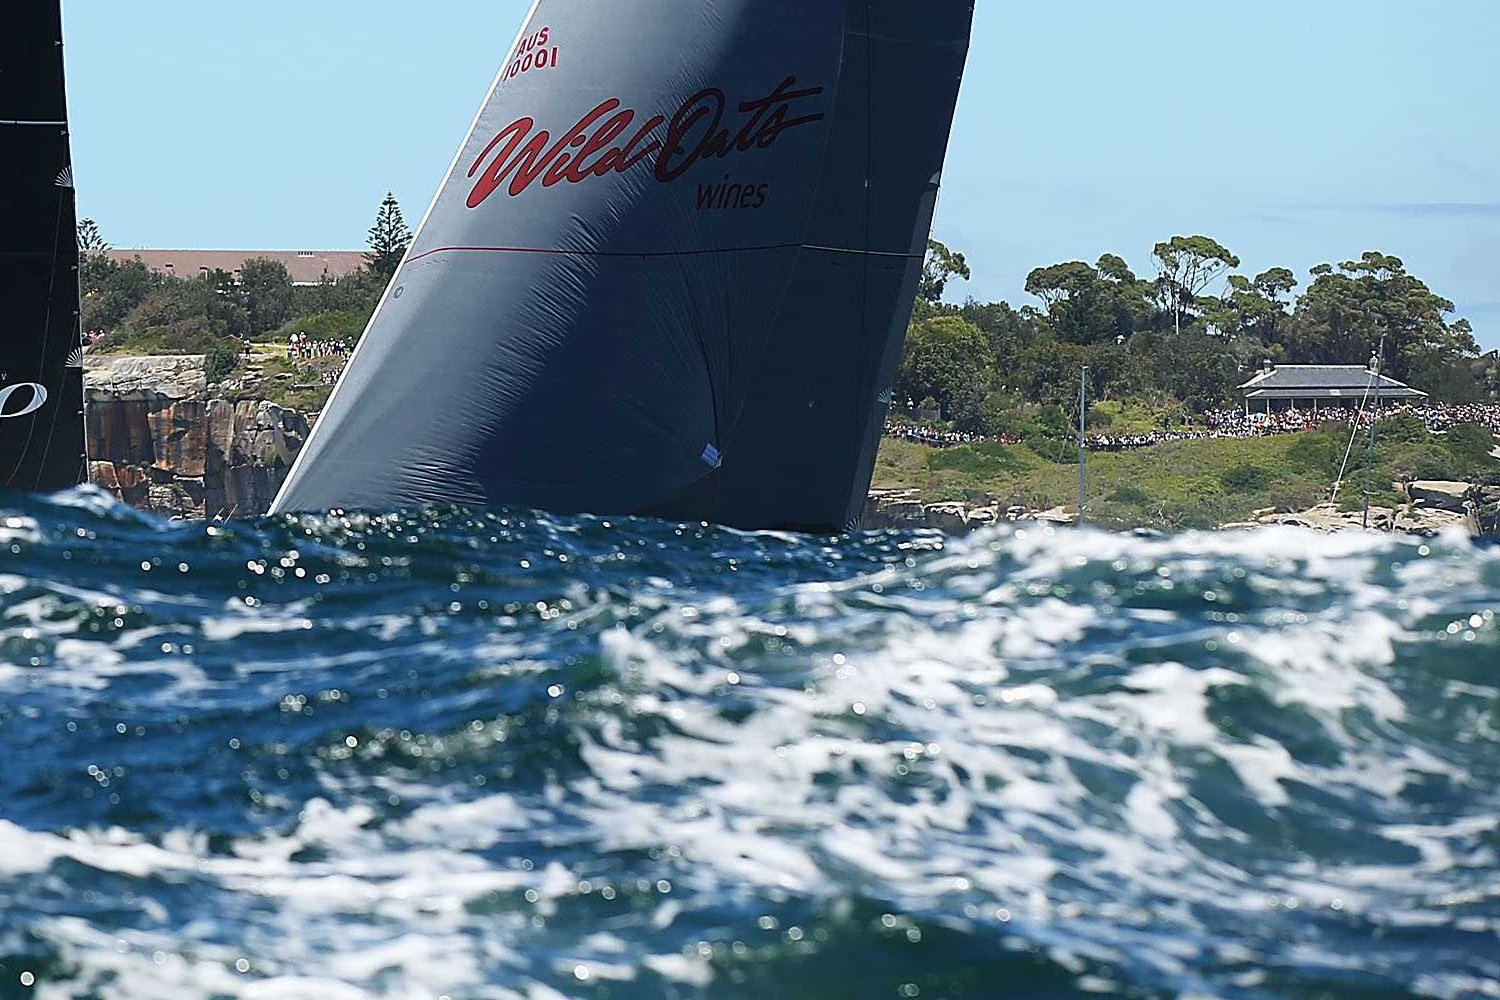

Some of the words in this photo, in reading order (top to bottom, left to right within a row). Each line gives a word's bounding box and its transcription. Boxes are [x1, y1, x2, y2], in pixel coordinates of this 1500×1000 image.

[516, 26, 550, 58] AUS
[503, 46, 558, 82] 10001
[465, 97, 664, 209] Wild
[654, 75, 824, 184] Oats
[695, 173, 769, 210] wines
